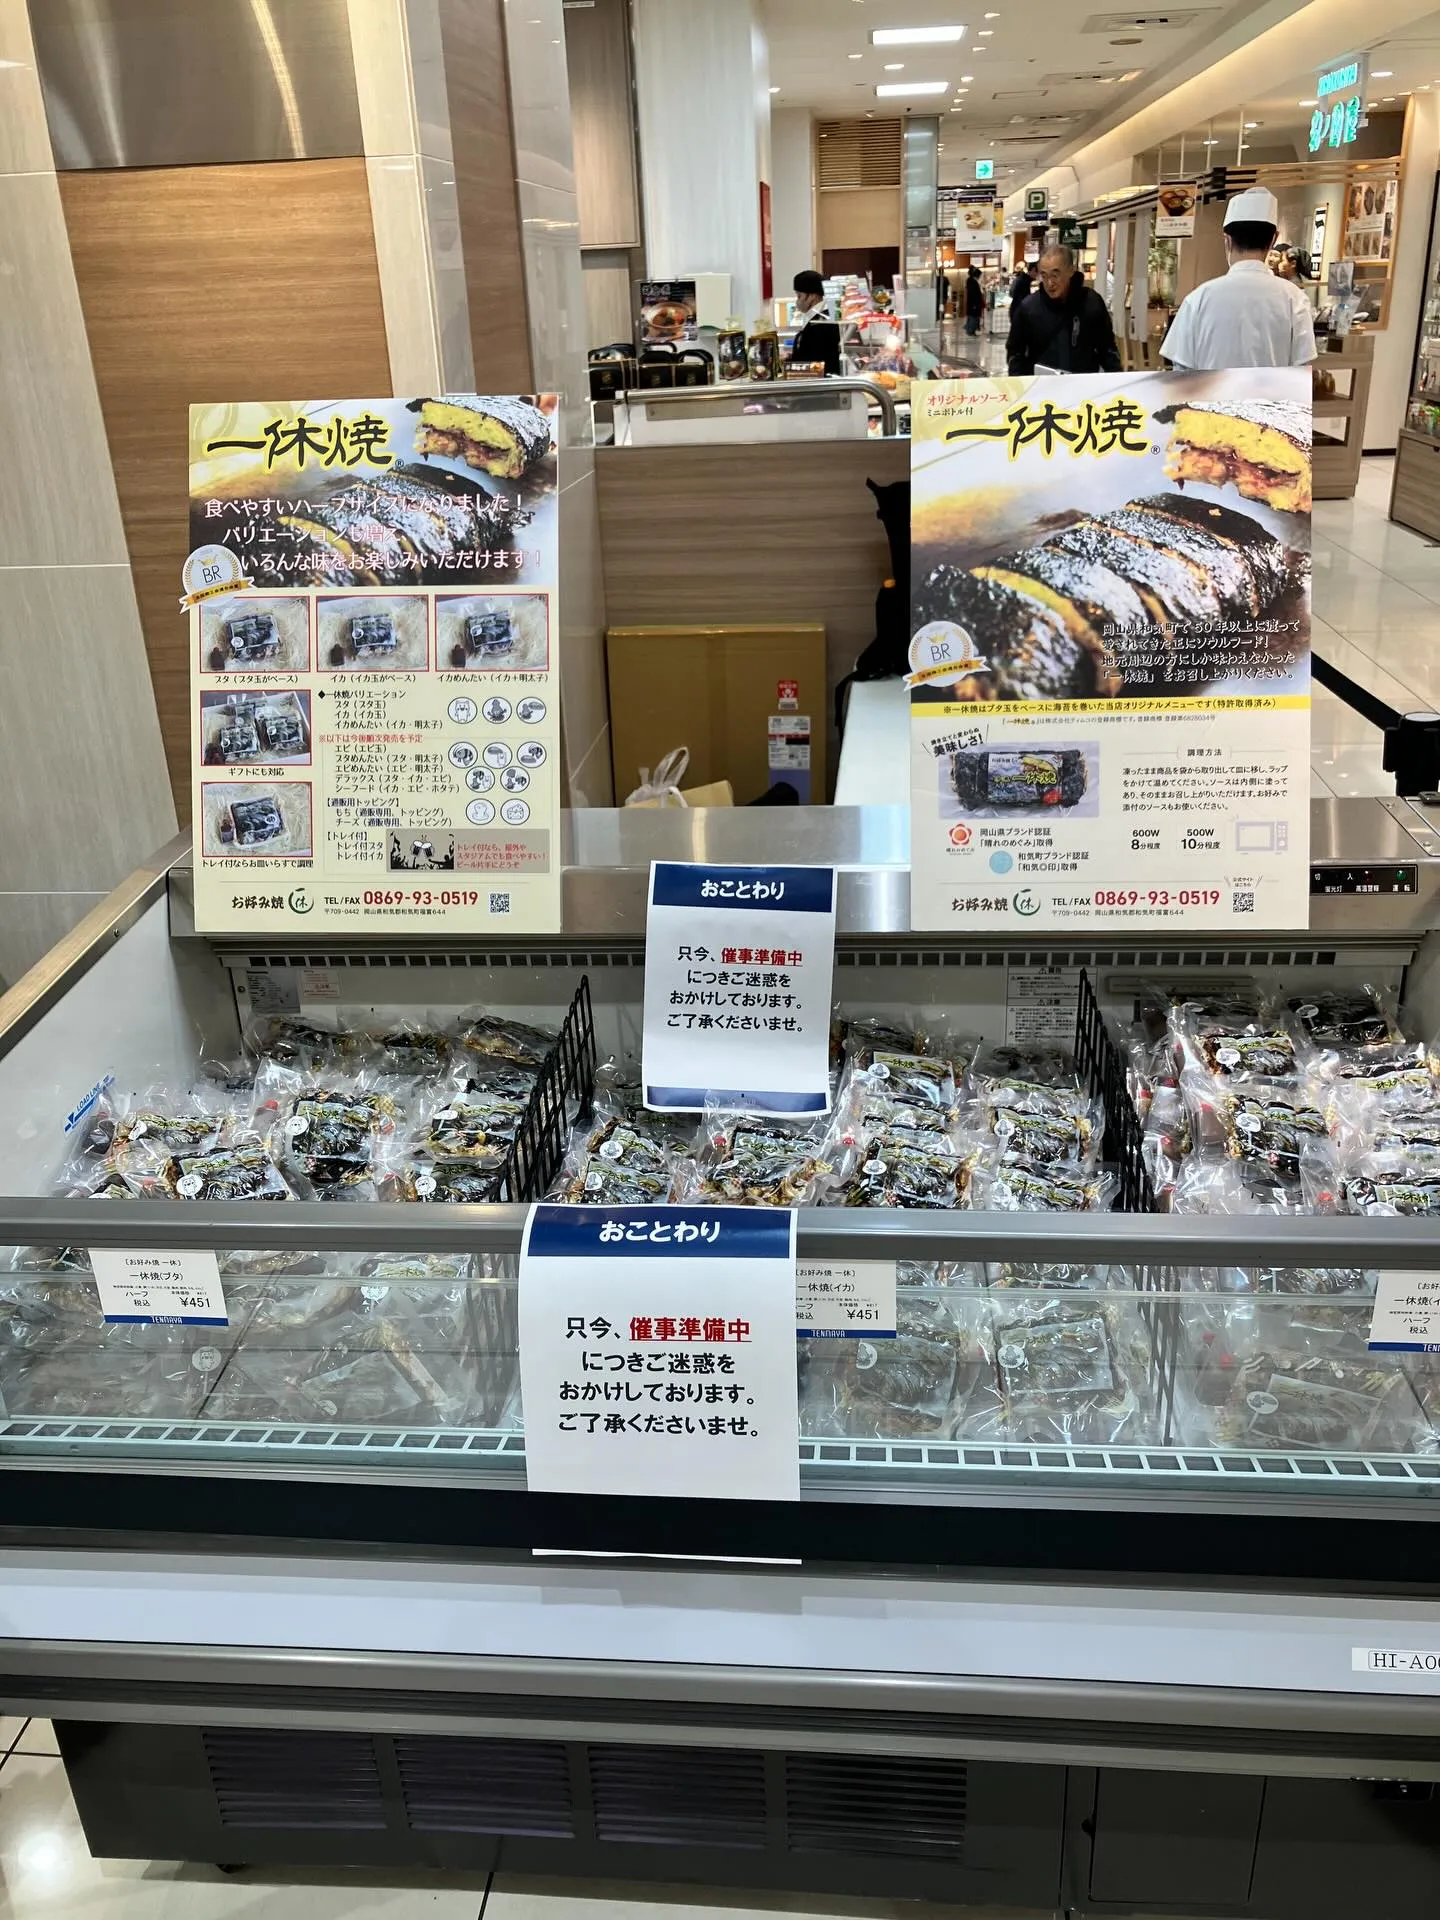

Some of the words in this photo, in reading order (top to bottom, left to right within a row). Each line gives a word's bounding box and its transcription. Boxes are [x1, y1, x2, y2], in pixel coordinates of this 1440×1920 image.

[1031, 192, 1043, 209] P
[927, 393, 1009, 405] オリジナルソース
[927, 407, 973, 417] ミニボトル付
[946, 400, 1148, 457] 一休焼
[207, 415, 392, 468] 一休焼
[204, 493, 523, 519] 食べやすいハーフサイズになりました！
[222, 525, 407, 545] バリエーションも増え、
[241, 550, 542, 572] いろんな味をお楽しみいただけます！
[202, 565, 222, 583] BR
[930, 643, 951, 662] BR
[1101, 651, 1296, 667] 地元周辺の方にしか味わえなかった
[215, 675, 300, 684] ブタ（ブタ玉がベース）
[330, 675, 417, 684] イカ（イカ玉がベース）
[334, 710, 387, 719] イカ（イカ玉）
[334, 720, 443, 729] イカめんたい（イカ・明太子）
[334, 744, 387, 753] エビ（エビ玉）
[1187, 749, 1222, 757] 調理方法
[228, 768, 285, 777] ギフトにも対応
[335, 764, 444, 773] エビめんたい（エビ・明太子）
[1122, 803, 1229, 812] 添付のソースもお使いください。
[979, 828, 1052, 836] 岡山県ブランド認証
[1132, 829, 1160, 837] 600W
[1187, 829, 1214, 837] 500W
[980, 839, 1053, 848] 「晴れのめぐみ」取得
[1131, 839, 1161, 850] 8分程度
[1181, 838, 1221, 850] 10分程度
[336, 852, 383, 861] トレイ付イカ
[1018, 852, 1089, 860] 和気町ブランド認証
[700, 879, 785, 901] おことわり
[231, 895, 285, 910] お好み焼
[363, 890, 479, 905] 0869-93-0519
[951, 897, 1008, 911] お好み焼
[1095, 890, 1220, 906] 0869-93-0519
[677, 946, 803, 967] 只今、催事準備中
[687, 969, 791, 988] につきご迷惑を
[669, 990, 803, 1010] おかけしております。
[666, 1013, 804, 1033] ご了承くださいませ。
[77, 1094, 90, 1111] LOAD
[599, 1220, 720, 1243] おことわり
[129, 1271, 183, 1281] 一休焼(ブタ)
[797, 1283, 855, 1292] 一休焼(イカ)
[133, 1299, 151, 1307] 税込
[179, 1297, 211, 1308] ¥451
[796, 1312, 814, 1320] 税込
[846, 1310, 879, 1320] ¥451
[565, 1316, 752, 1342] 只今、催事準備中
[1409, 1326, 1429, 1335] 税込
[582, 1351, 736, 1375] につきご迷惑を
[558, 1380, 755, 1406] おかけしております。
[558, 1413, 758, 1437] ご了承くださいませ。
